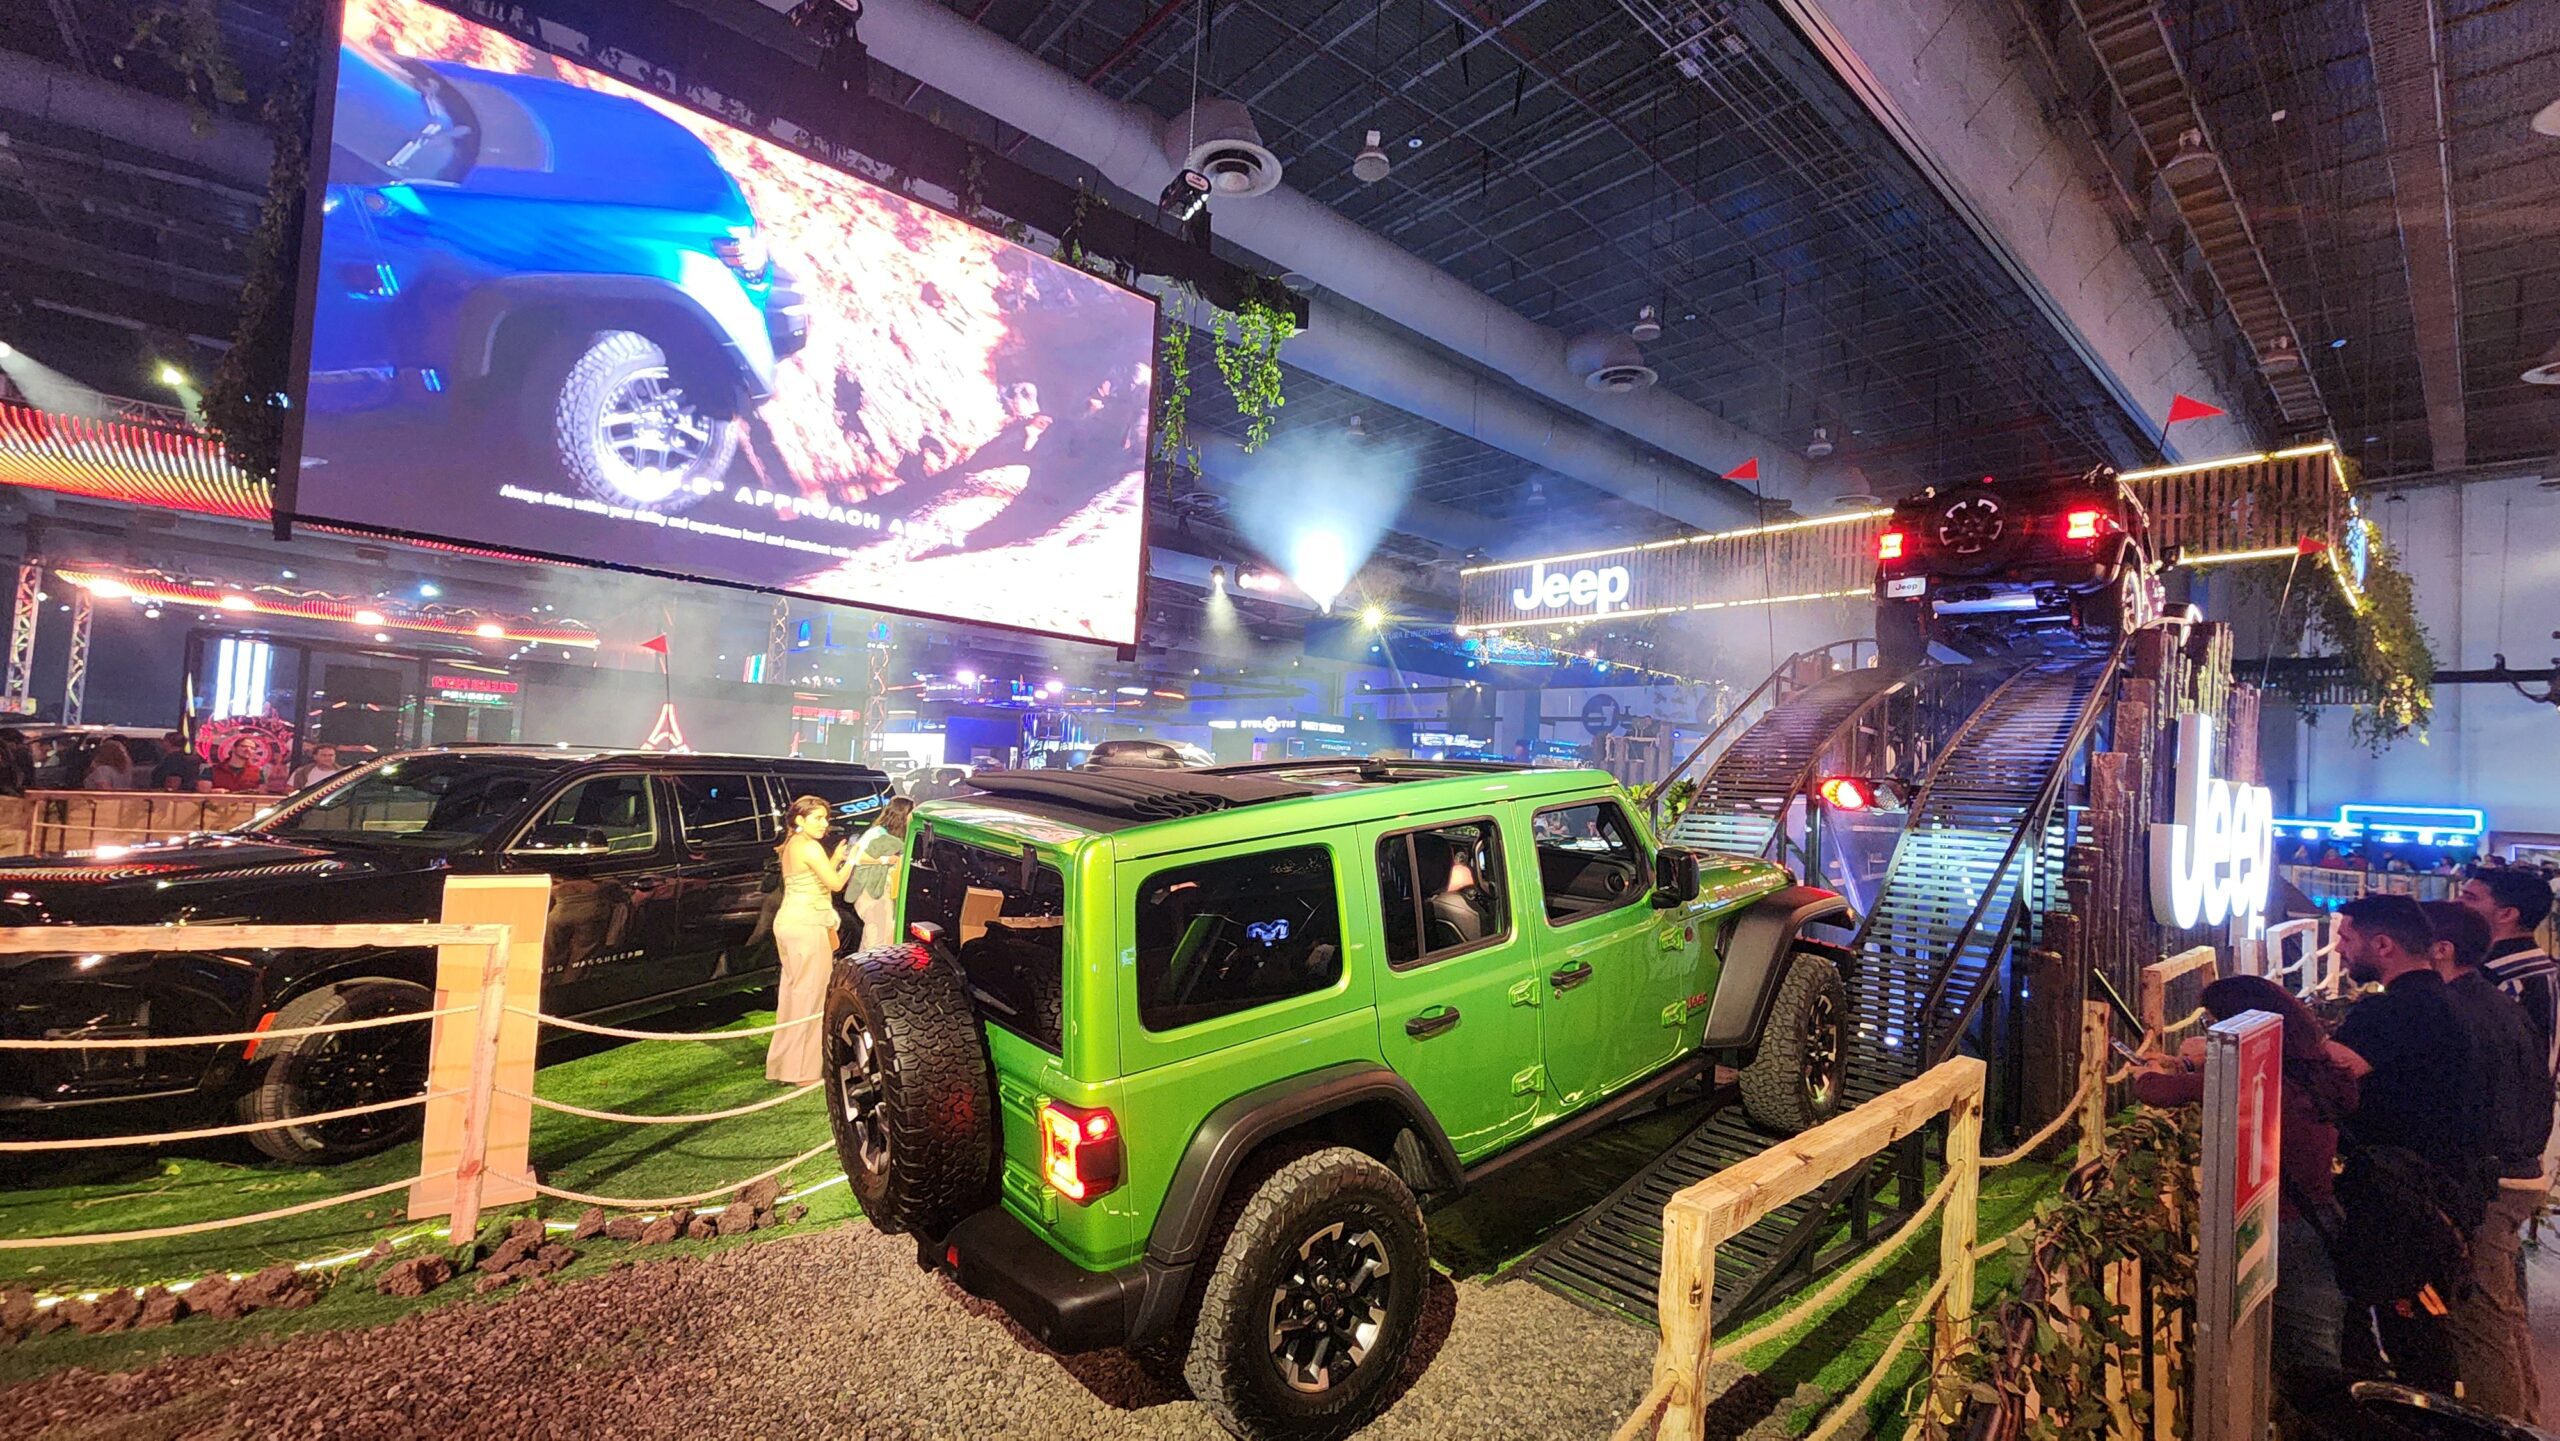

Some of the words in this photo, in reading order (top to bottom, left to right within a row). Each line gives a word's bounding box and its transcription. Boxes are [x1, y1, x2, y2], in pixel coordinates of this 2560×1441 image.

[735, 486, 880, 530] APPROACH
[1513, 562, 1630, 613] Jeep
[1895, 583, 1918, 591] Jeep
[2150, 713, 2273, 941] Jeep
